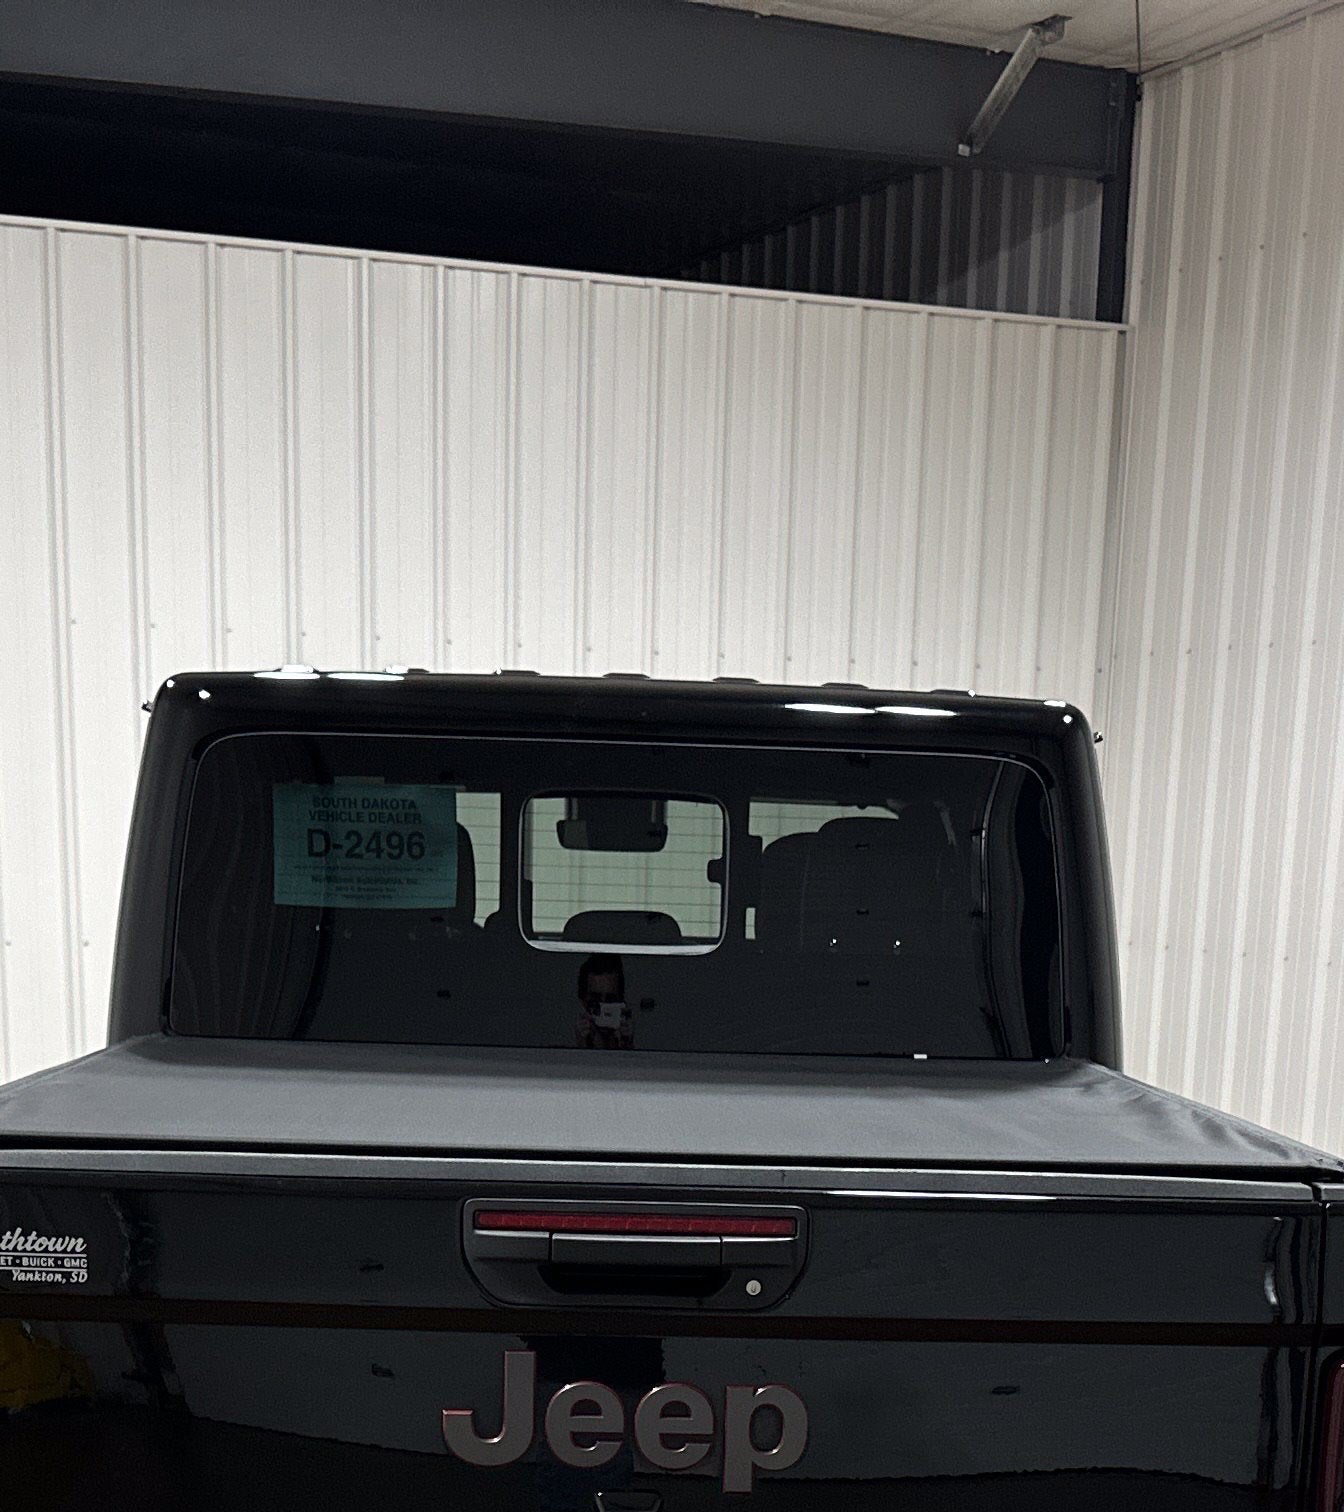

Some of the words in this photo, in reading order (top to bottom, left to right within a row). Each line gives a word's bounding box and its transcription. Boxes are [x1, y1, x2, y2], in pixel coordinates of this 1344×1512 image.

[312, 796, 358, 810] SOUTH
[361, 797, 417, 810] DAKOTA
[308, 809, 365, 823] VEHICLE
[367, 811, 423, 825] DEALER
[306, 828, 426, 861] D-2496
[21, 1256, 55, 1267] BUICK
[63, 1257, 88, 1268] GMC
[11, 1269, 67, 1284] Yankton,
[69, 1270, 88, 1283] SD
[441, 1350, 809, 1494] Jeep
